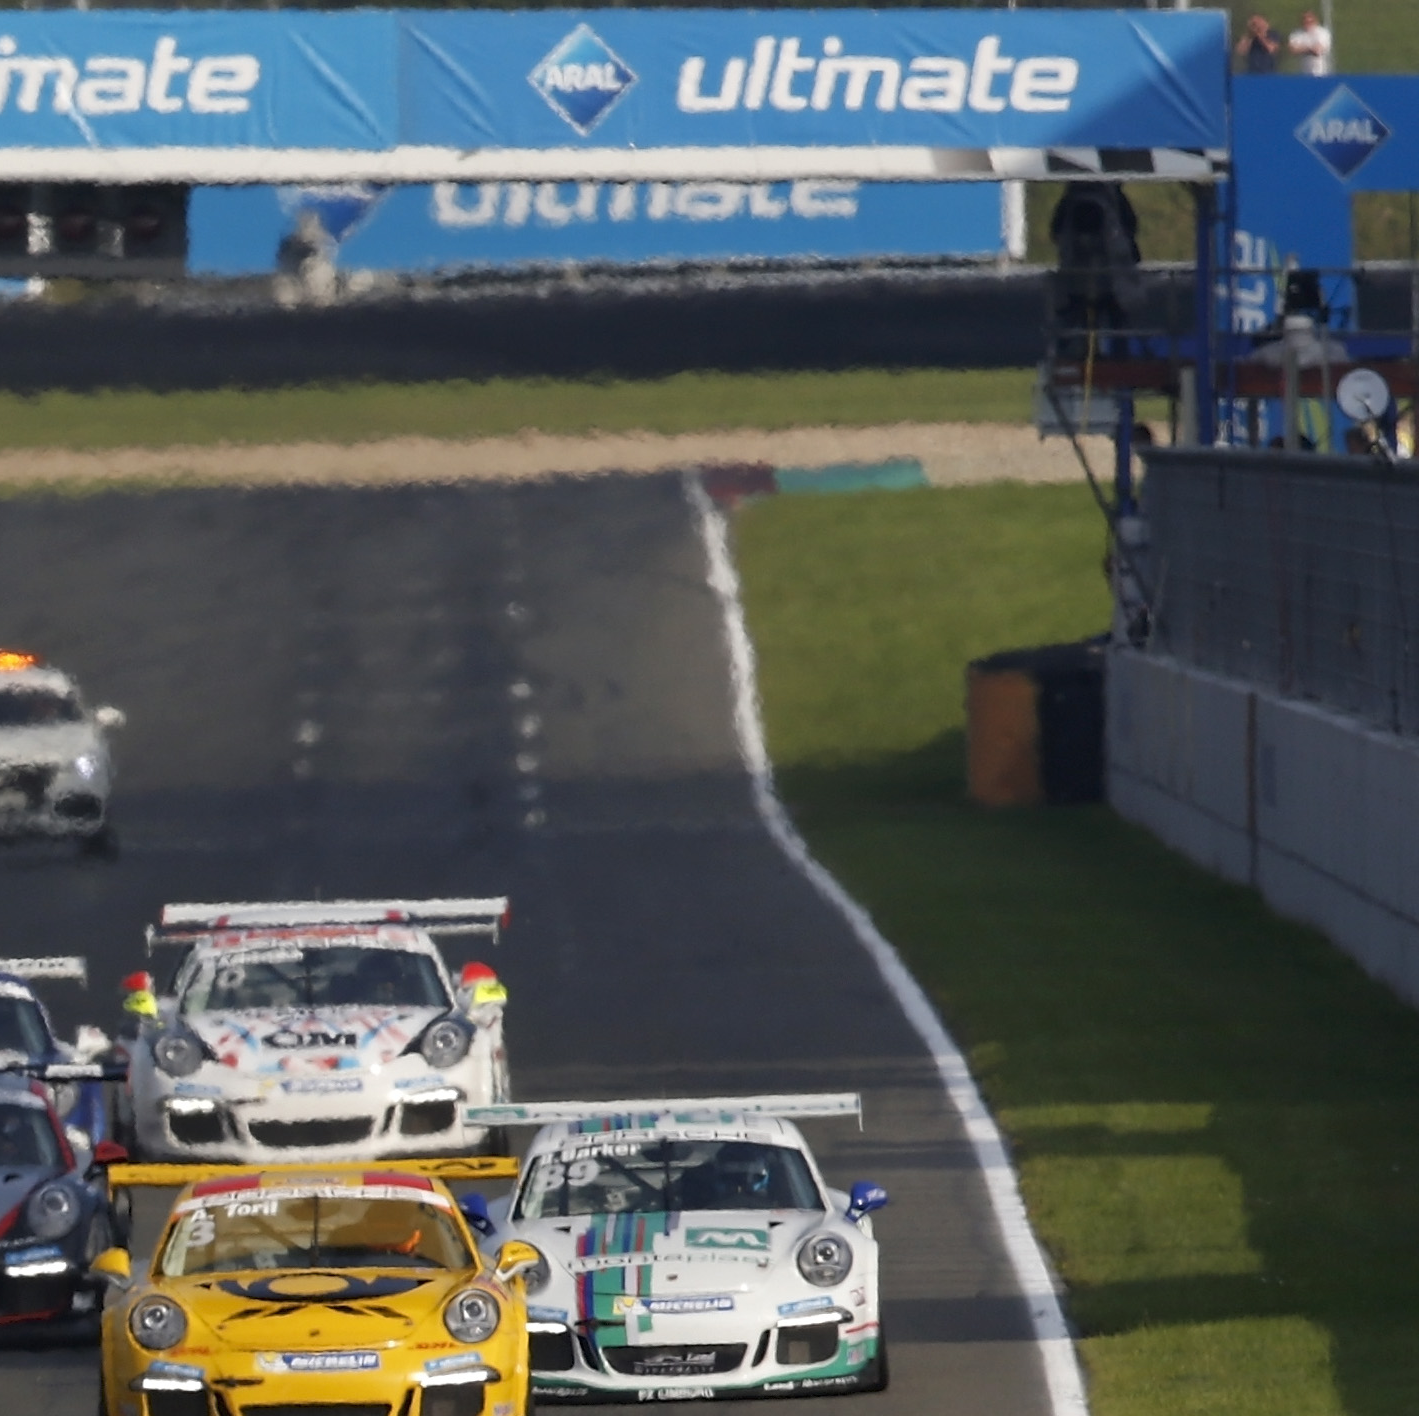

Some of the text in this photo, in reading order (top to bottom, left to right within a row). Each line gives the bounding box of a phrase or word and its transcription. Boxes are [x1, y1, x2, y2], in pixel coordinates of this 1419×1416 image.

[543, 36, 1078, 112] ARAL ultimate
[1308, 117, 1379, 146] ARAL
